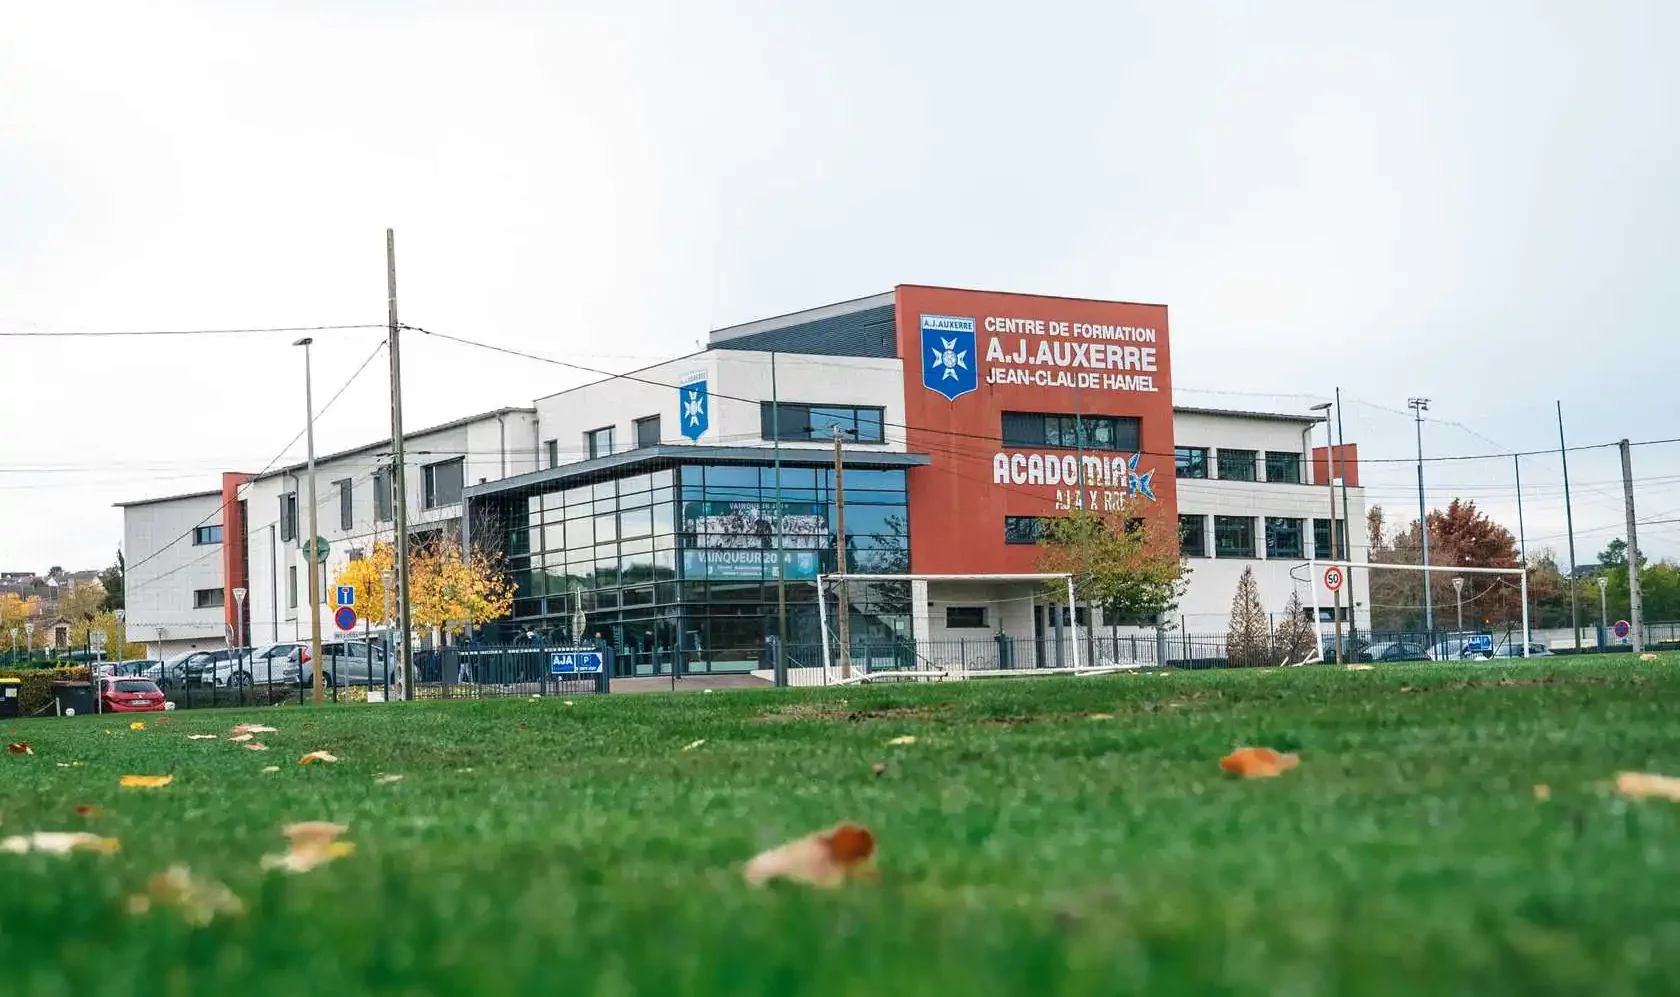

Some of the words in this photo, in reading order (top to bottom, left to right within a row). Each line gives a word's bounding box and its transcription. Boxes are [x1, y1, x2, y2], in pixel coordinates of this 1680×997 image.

[924, 319, 973, 330] A.J.AUXERRE
[984, 316, 1045, 335] CENTRE
[1049, 321, 1069, 336] DE
[1073, 322, 1156, 342] FORMATION
[986, 337, 1157, 371] A.J.AUXERRE
[986, 367, 1100, 388] JEAN-CLAUDE
[1103, 373, 1159, 391] HAMEL
[993, 452, 1127, 487] ACADOMIA
[764, 553, 792, 564] 204
[1328, 574, 1339, 584] 50
[553, 656, 573, 665] AJA
